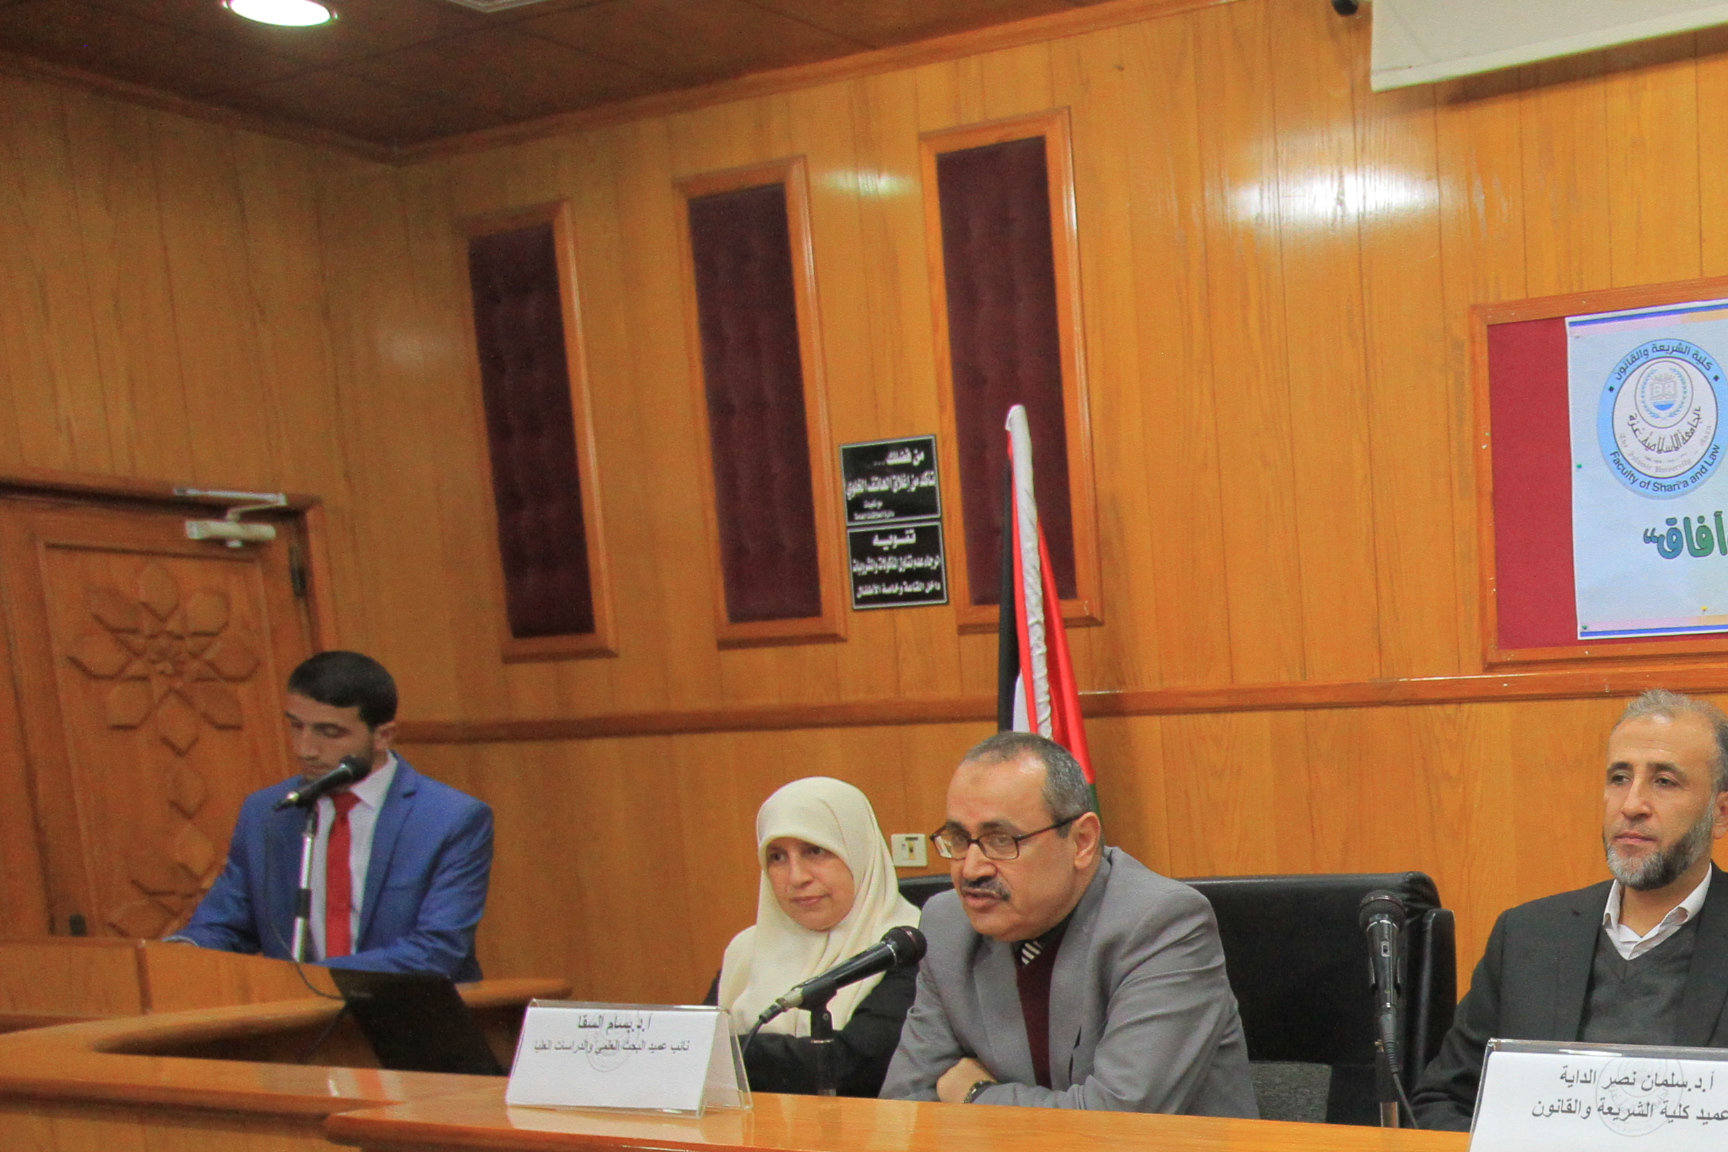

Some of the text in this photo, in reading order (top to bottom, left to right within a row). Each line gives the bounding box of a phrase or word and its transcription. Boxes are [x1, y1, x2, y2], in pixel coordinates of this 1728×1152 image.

[1615, 342, 1714, 381] كلية الشريعة والقانون
[1609, 449, 1639, 486] Faculty
[1639, 479, 1651, 490] of
[1690, 466, 1709, 484] and
[1706, 444, 1721, 467] Law
[554, 1039, 594, 1054] والدراسات
[595, 1039, 620, 1055] العلمي
[622, 1039, 645, 1054] البحث
[648, 1045, 667, 1054] عميد
[671, 1040, 690, 1054] نائب
[1559, 1065, 1597, 1089] الداية
[1602, 1071, 1636, 1090] نصر
[1531, 1098, 1591, 1119] والقانون
[1597, 1096, 1654, 1121] الشريعة
[1660, 1099, 1690, 1124] كلية
